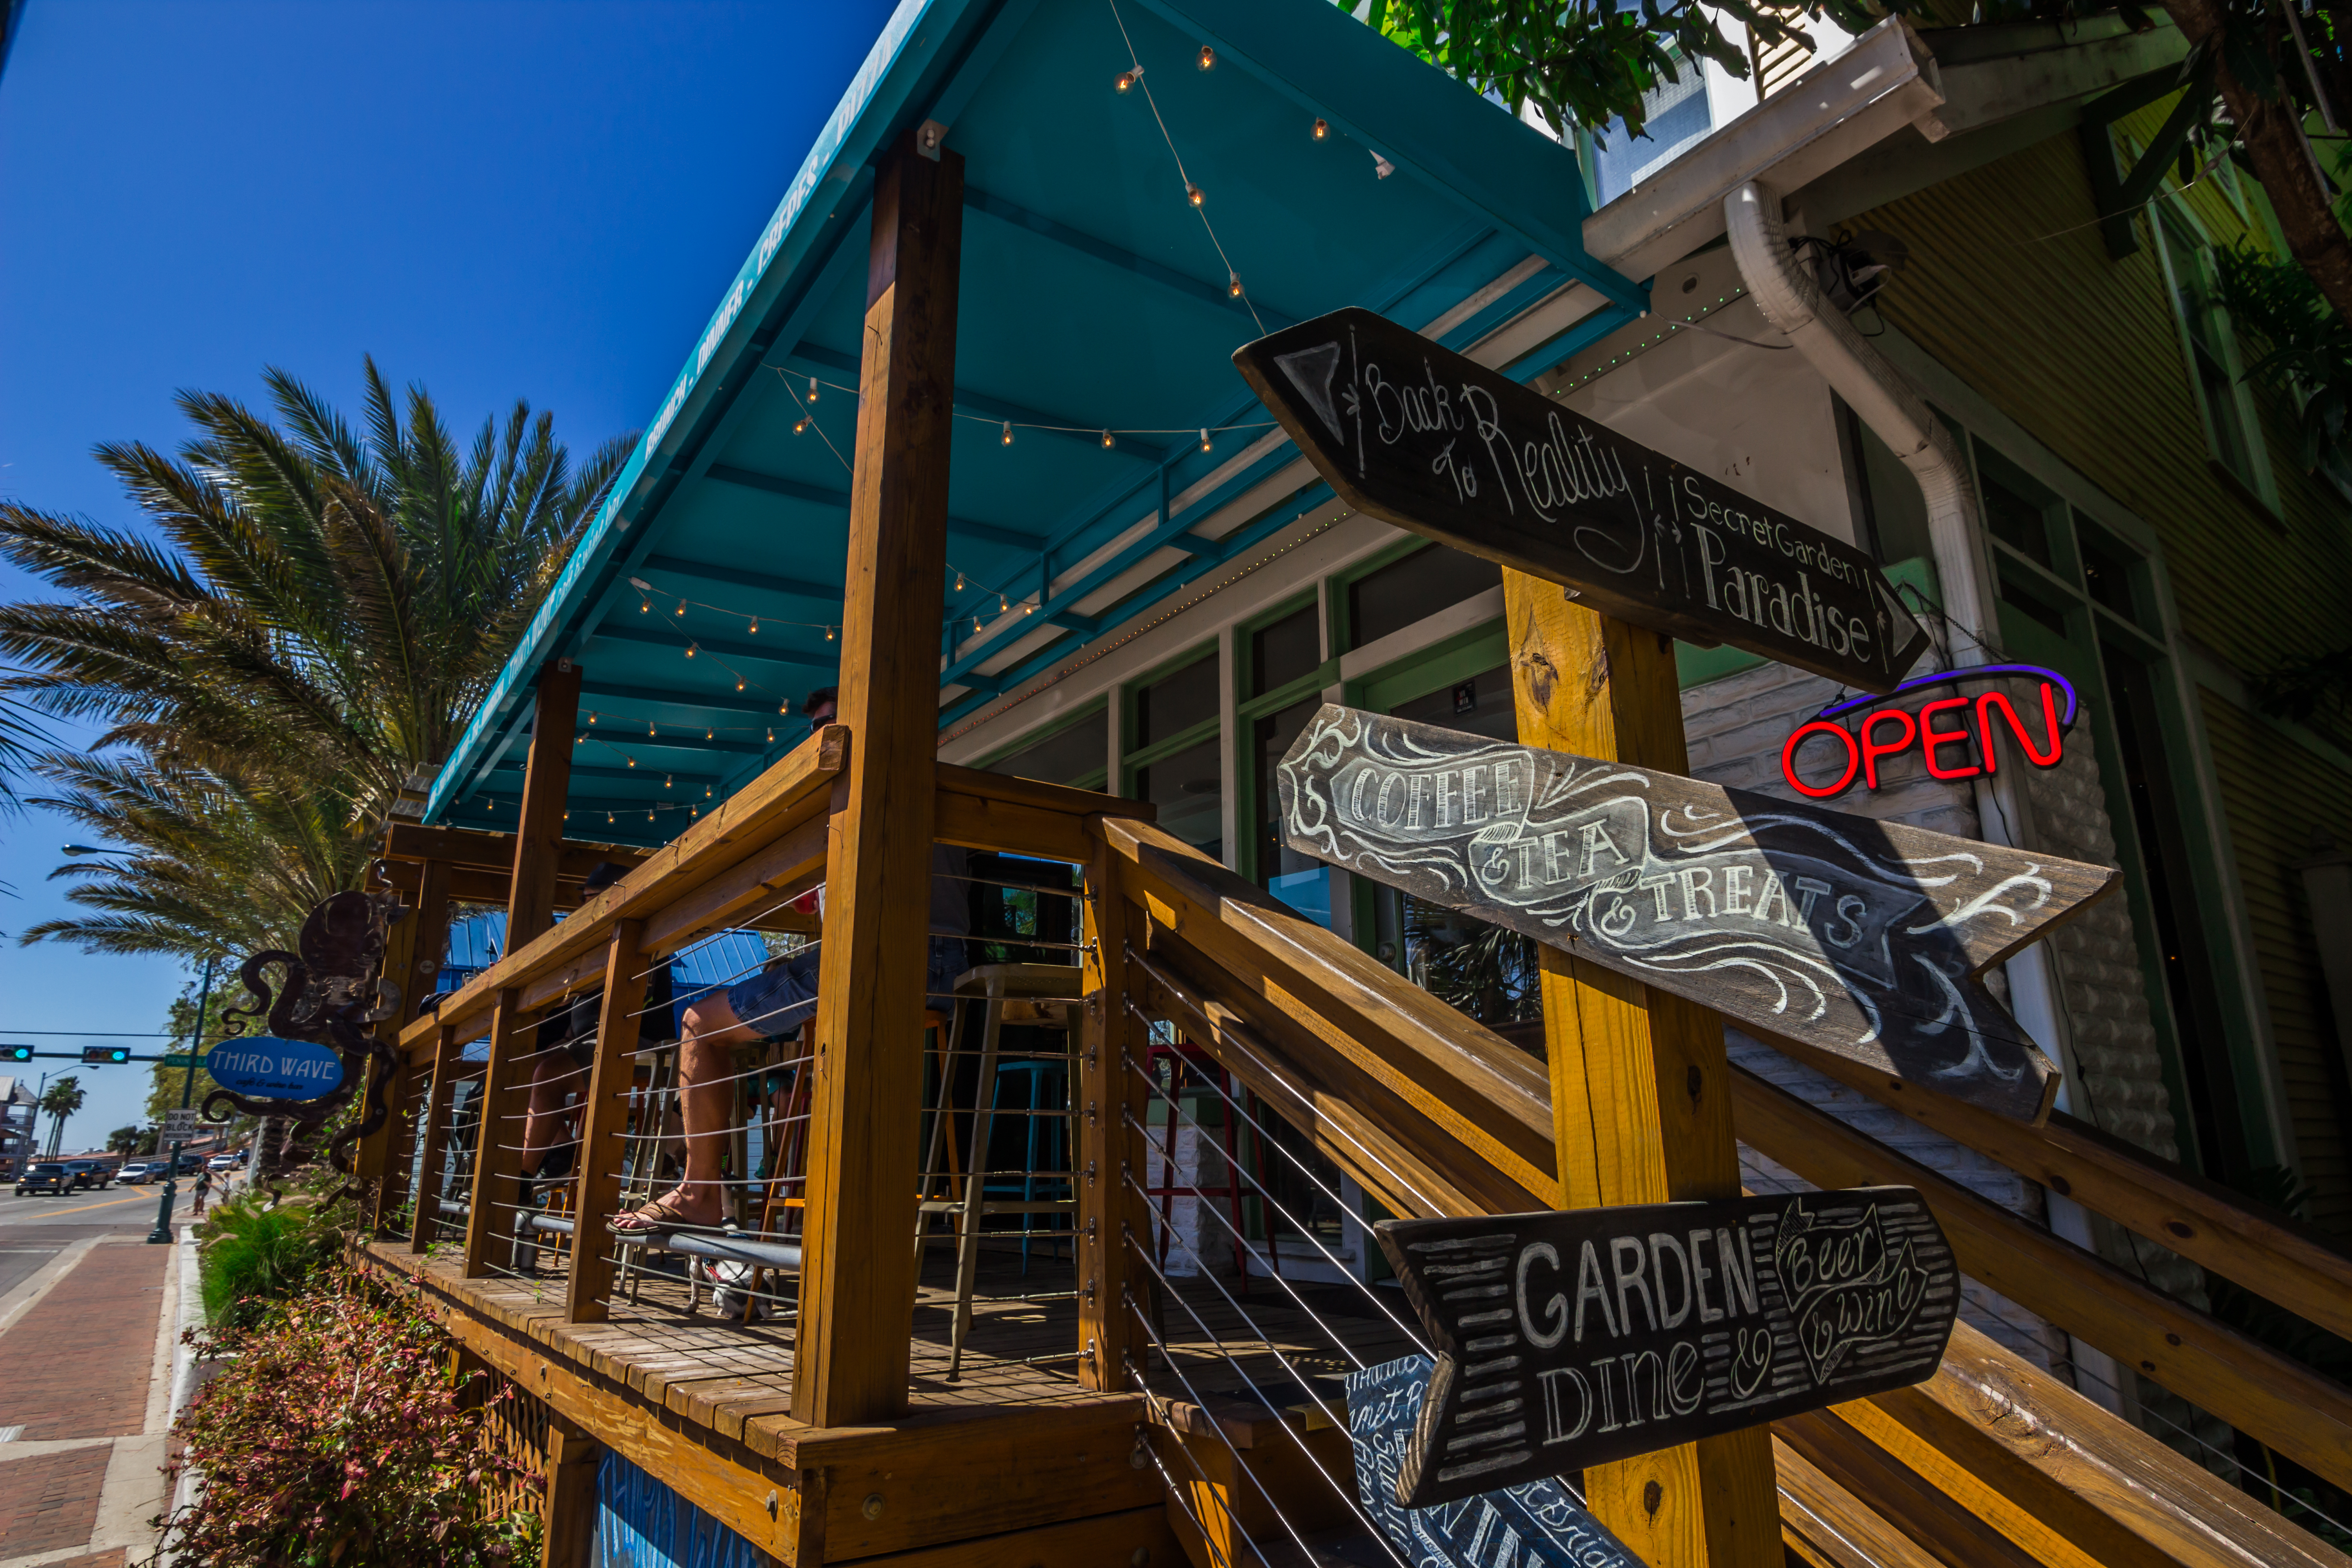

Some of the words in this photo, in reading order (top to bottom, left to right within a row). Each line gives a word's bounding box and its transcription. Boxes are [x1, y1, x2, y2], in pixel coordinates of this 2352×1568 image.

[1366, 357, 1464, 444] Back
[1460, 384, 1644, 573] Reality
[1684, 476, 1772, 549] Secret
[1775, 524, 1859, 589] Garden
[1690, 523, 1871, 663] Paradise
[1781, 682, 2063, 797] OPEN
[1351, 759, 1524, 830] COFFEE
[1518, 819, 1630, 891] TEA
[1641, 863, 1870, 950] TREATS
[214, 1051, 273, 1074] THIRD
[281, 1057, 336, 1080] WAVE
[1517, 1226, 1759, 1348] GARDEN
[1787, 1226, 1874, 1293] Beer
